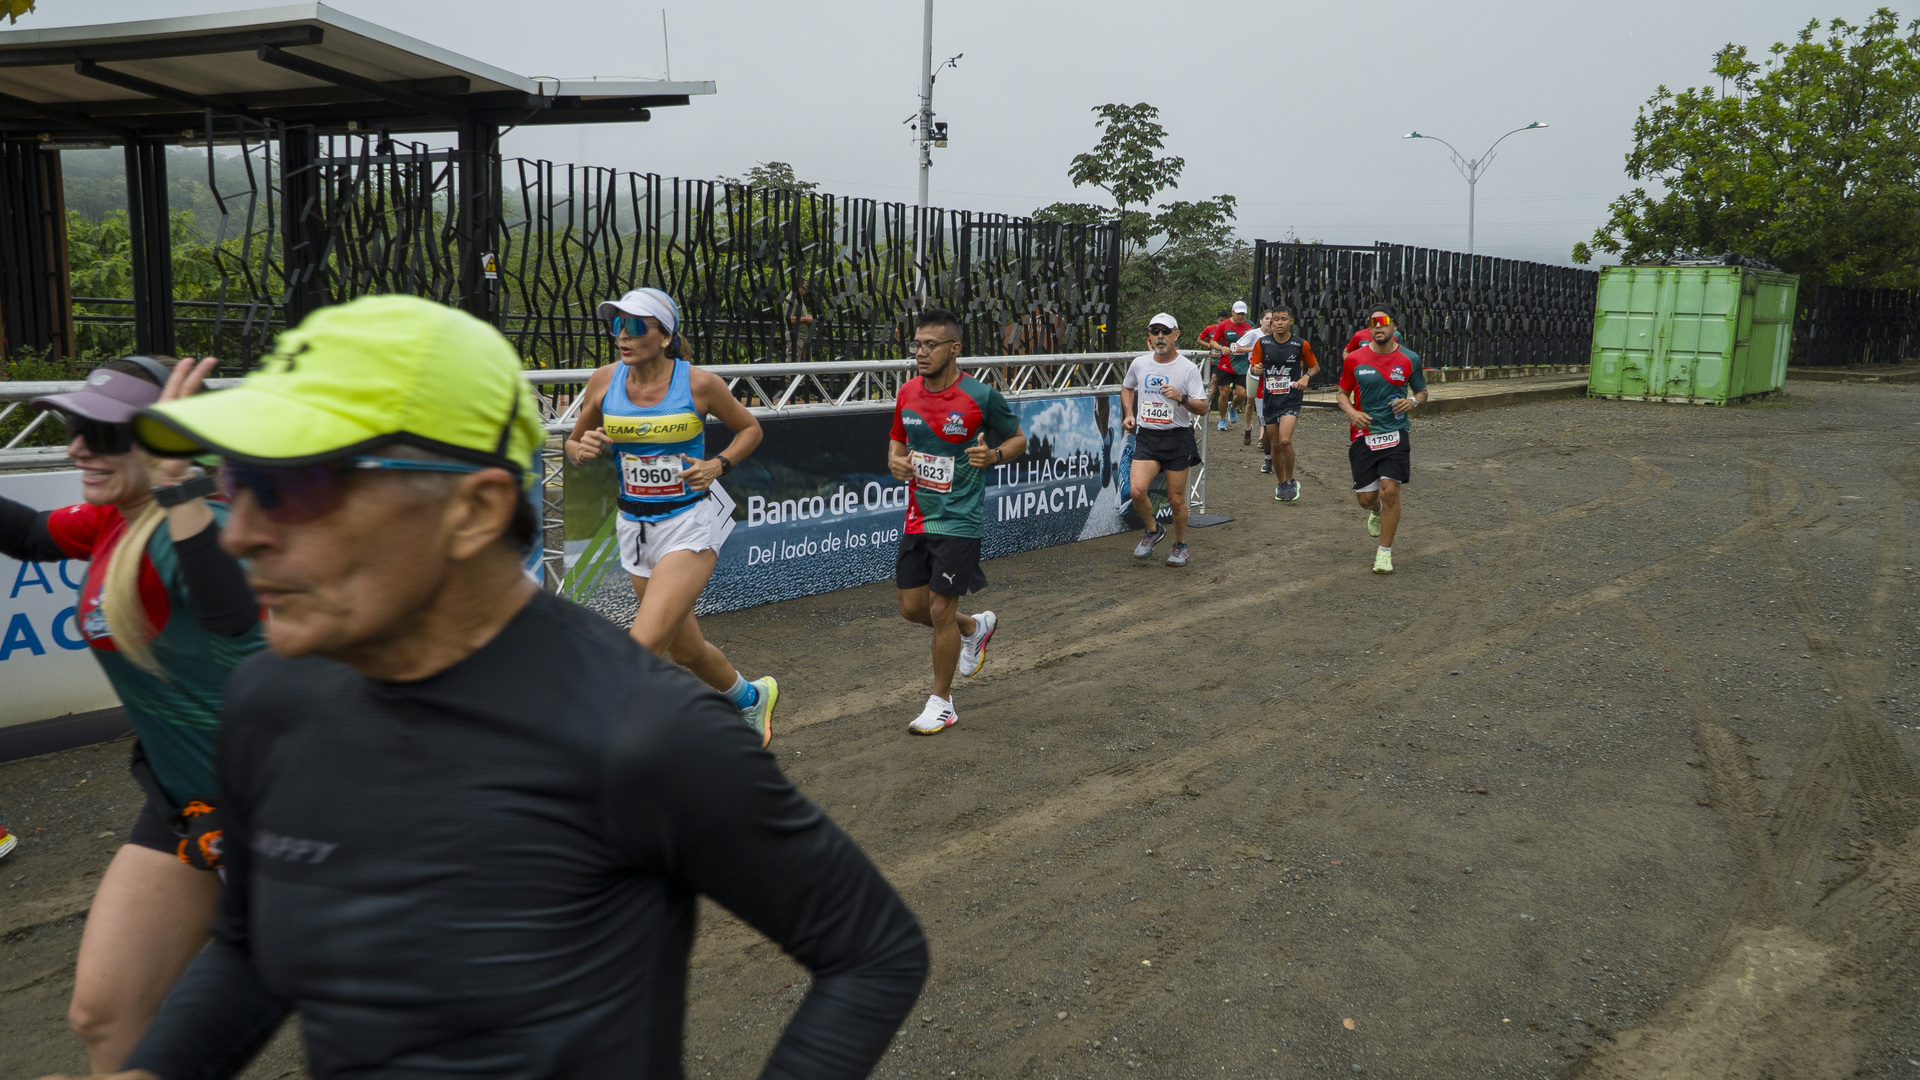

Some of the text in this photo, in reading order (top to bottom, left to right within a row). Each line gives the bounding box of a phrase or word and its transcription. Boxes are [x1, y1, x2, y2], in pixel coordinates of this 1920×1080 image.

[1147, 408, 1168, 418] 1404
[607, 423, 688, 434] TEAM CAPRI
[1371, 434, 1394, 444] 1790
[631, 467, 672, 484] 1960
[917, 464, 944, 481] 1623
[994, 454, 1094, 489] TU HACER,
[748, 495, 825, 528] Banco
[830, 485, 859, 515] de
[998, 484, 1094, 522] IMPACTA.
[748, 541, 777, 566] Del
[780, 536, 818, 561] lado
[821, 532, 841, 553] de
[845, 529, 867, 549] los
[871, 528, 899, 549] que
